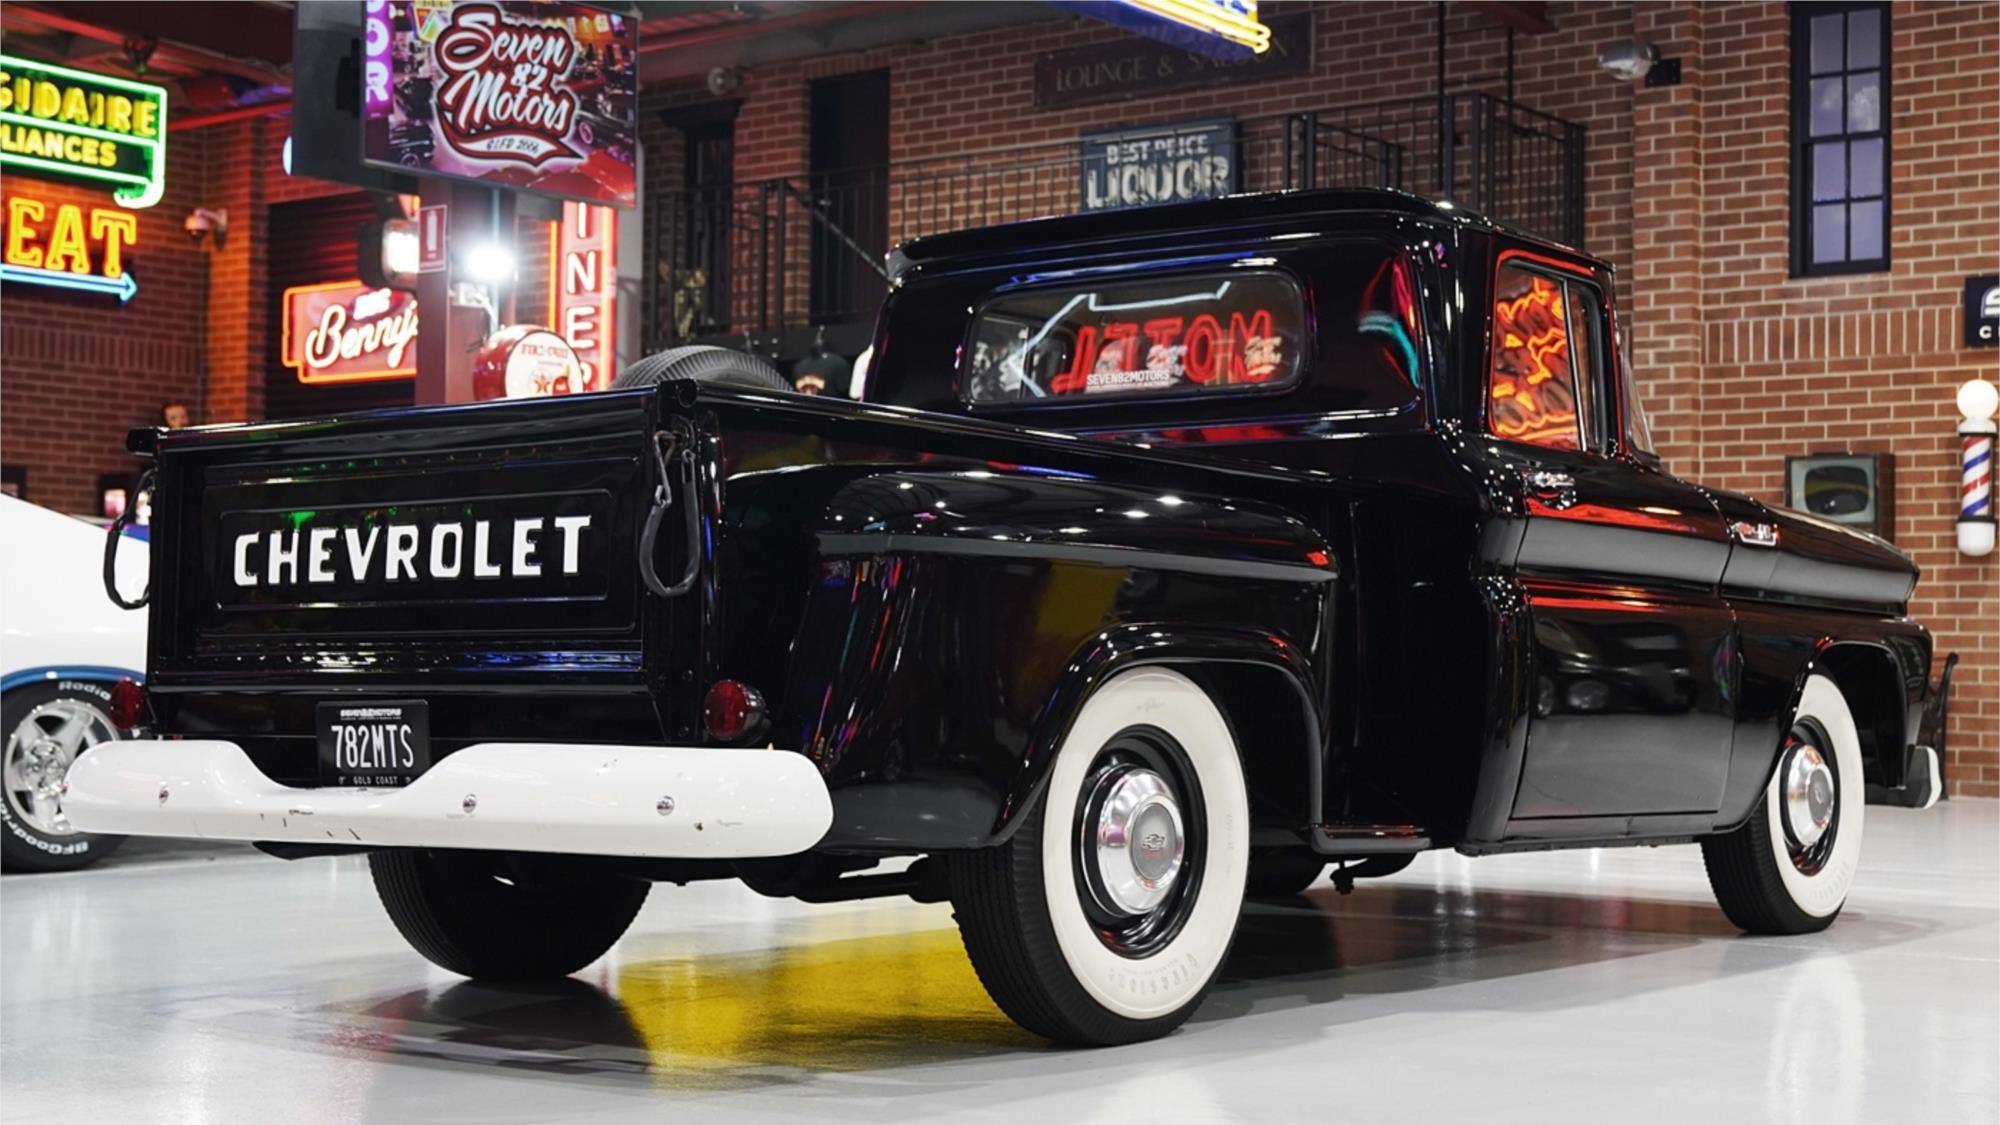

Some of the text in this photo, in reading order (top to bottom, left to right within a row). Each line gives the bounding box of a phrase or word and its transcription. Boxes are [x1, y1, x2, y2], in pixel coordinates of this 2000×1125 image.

[442, 12, 569, 71] Seven
[510, 63, 549, 91] 82
[1056, 56, 1147, 92] LOUNGE
[1157, 58, 1174, 77] &
[444, 70, 570, 131] Motors
[1107, 140, 1151, 165] BEST
[1087, 155, 1230, 208] LIQUOR
[7, 196, 137, 279] EAT
[1086, 370, 1170, 385] SEVEN82MOTORS
[234, 514, 592, 587] CHEVROLET
[331, 724, 414, 768] 782MTS
[353, 776, 398, 785] GOLD COAST
[0, 798, 89, 855] BFGoodric
